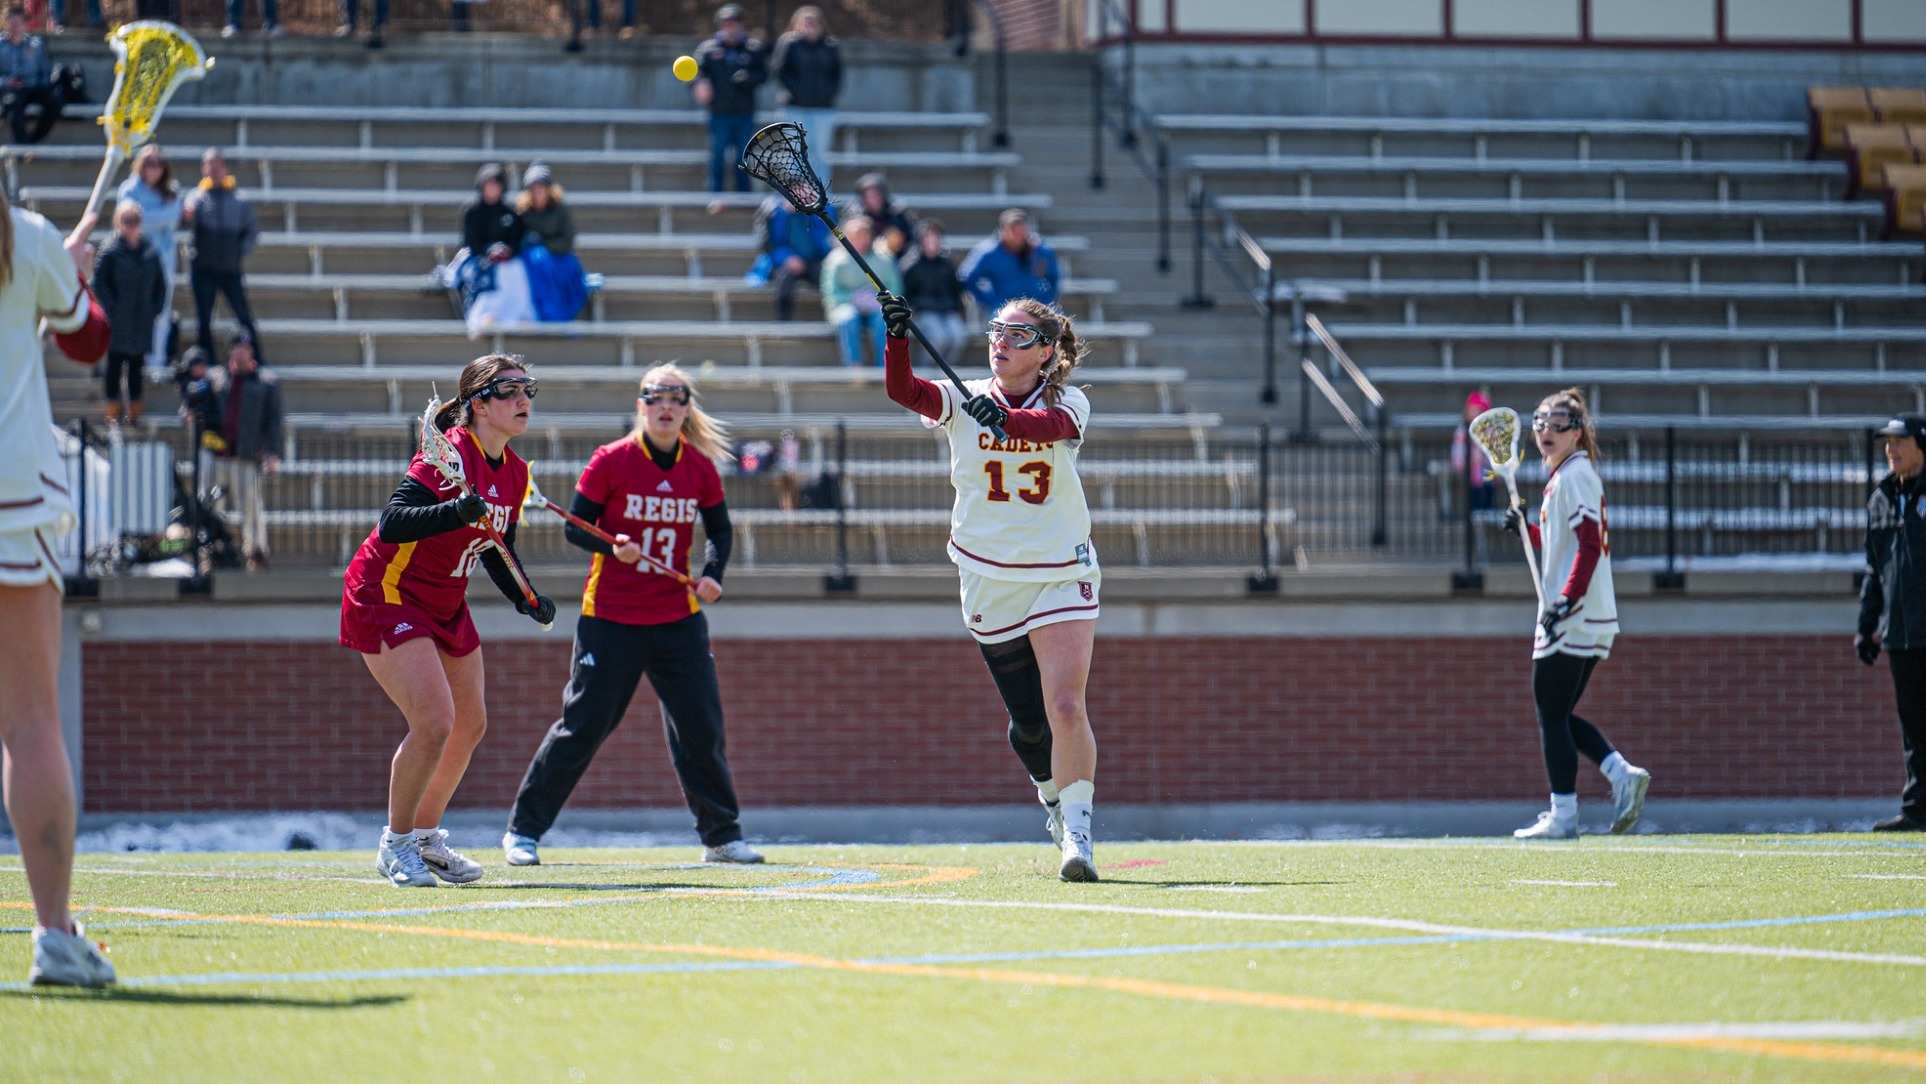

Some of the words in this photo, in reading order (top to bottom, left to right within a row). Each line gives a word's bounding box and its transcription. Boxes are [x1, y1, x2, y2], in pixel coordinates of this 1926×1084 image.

[984, 460, 1052, 505] 13
[465, 502, 513, 534] EGI
[623, 494, 699, 523] REGIS
[636, 527, 677, 574] 13
